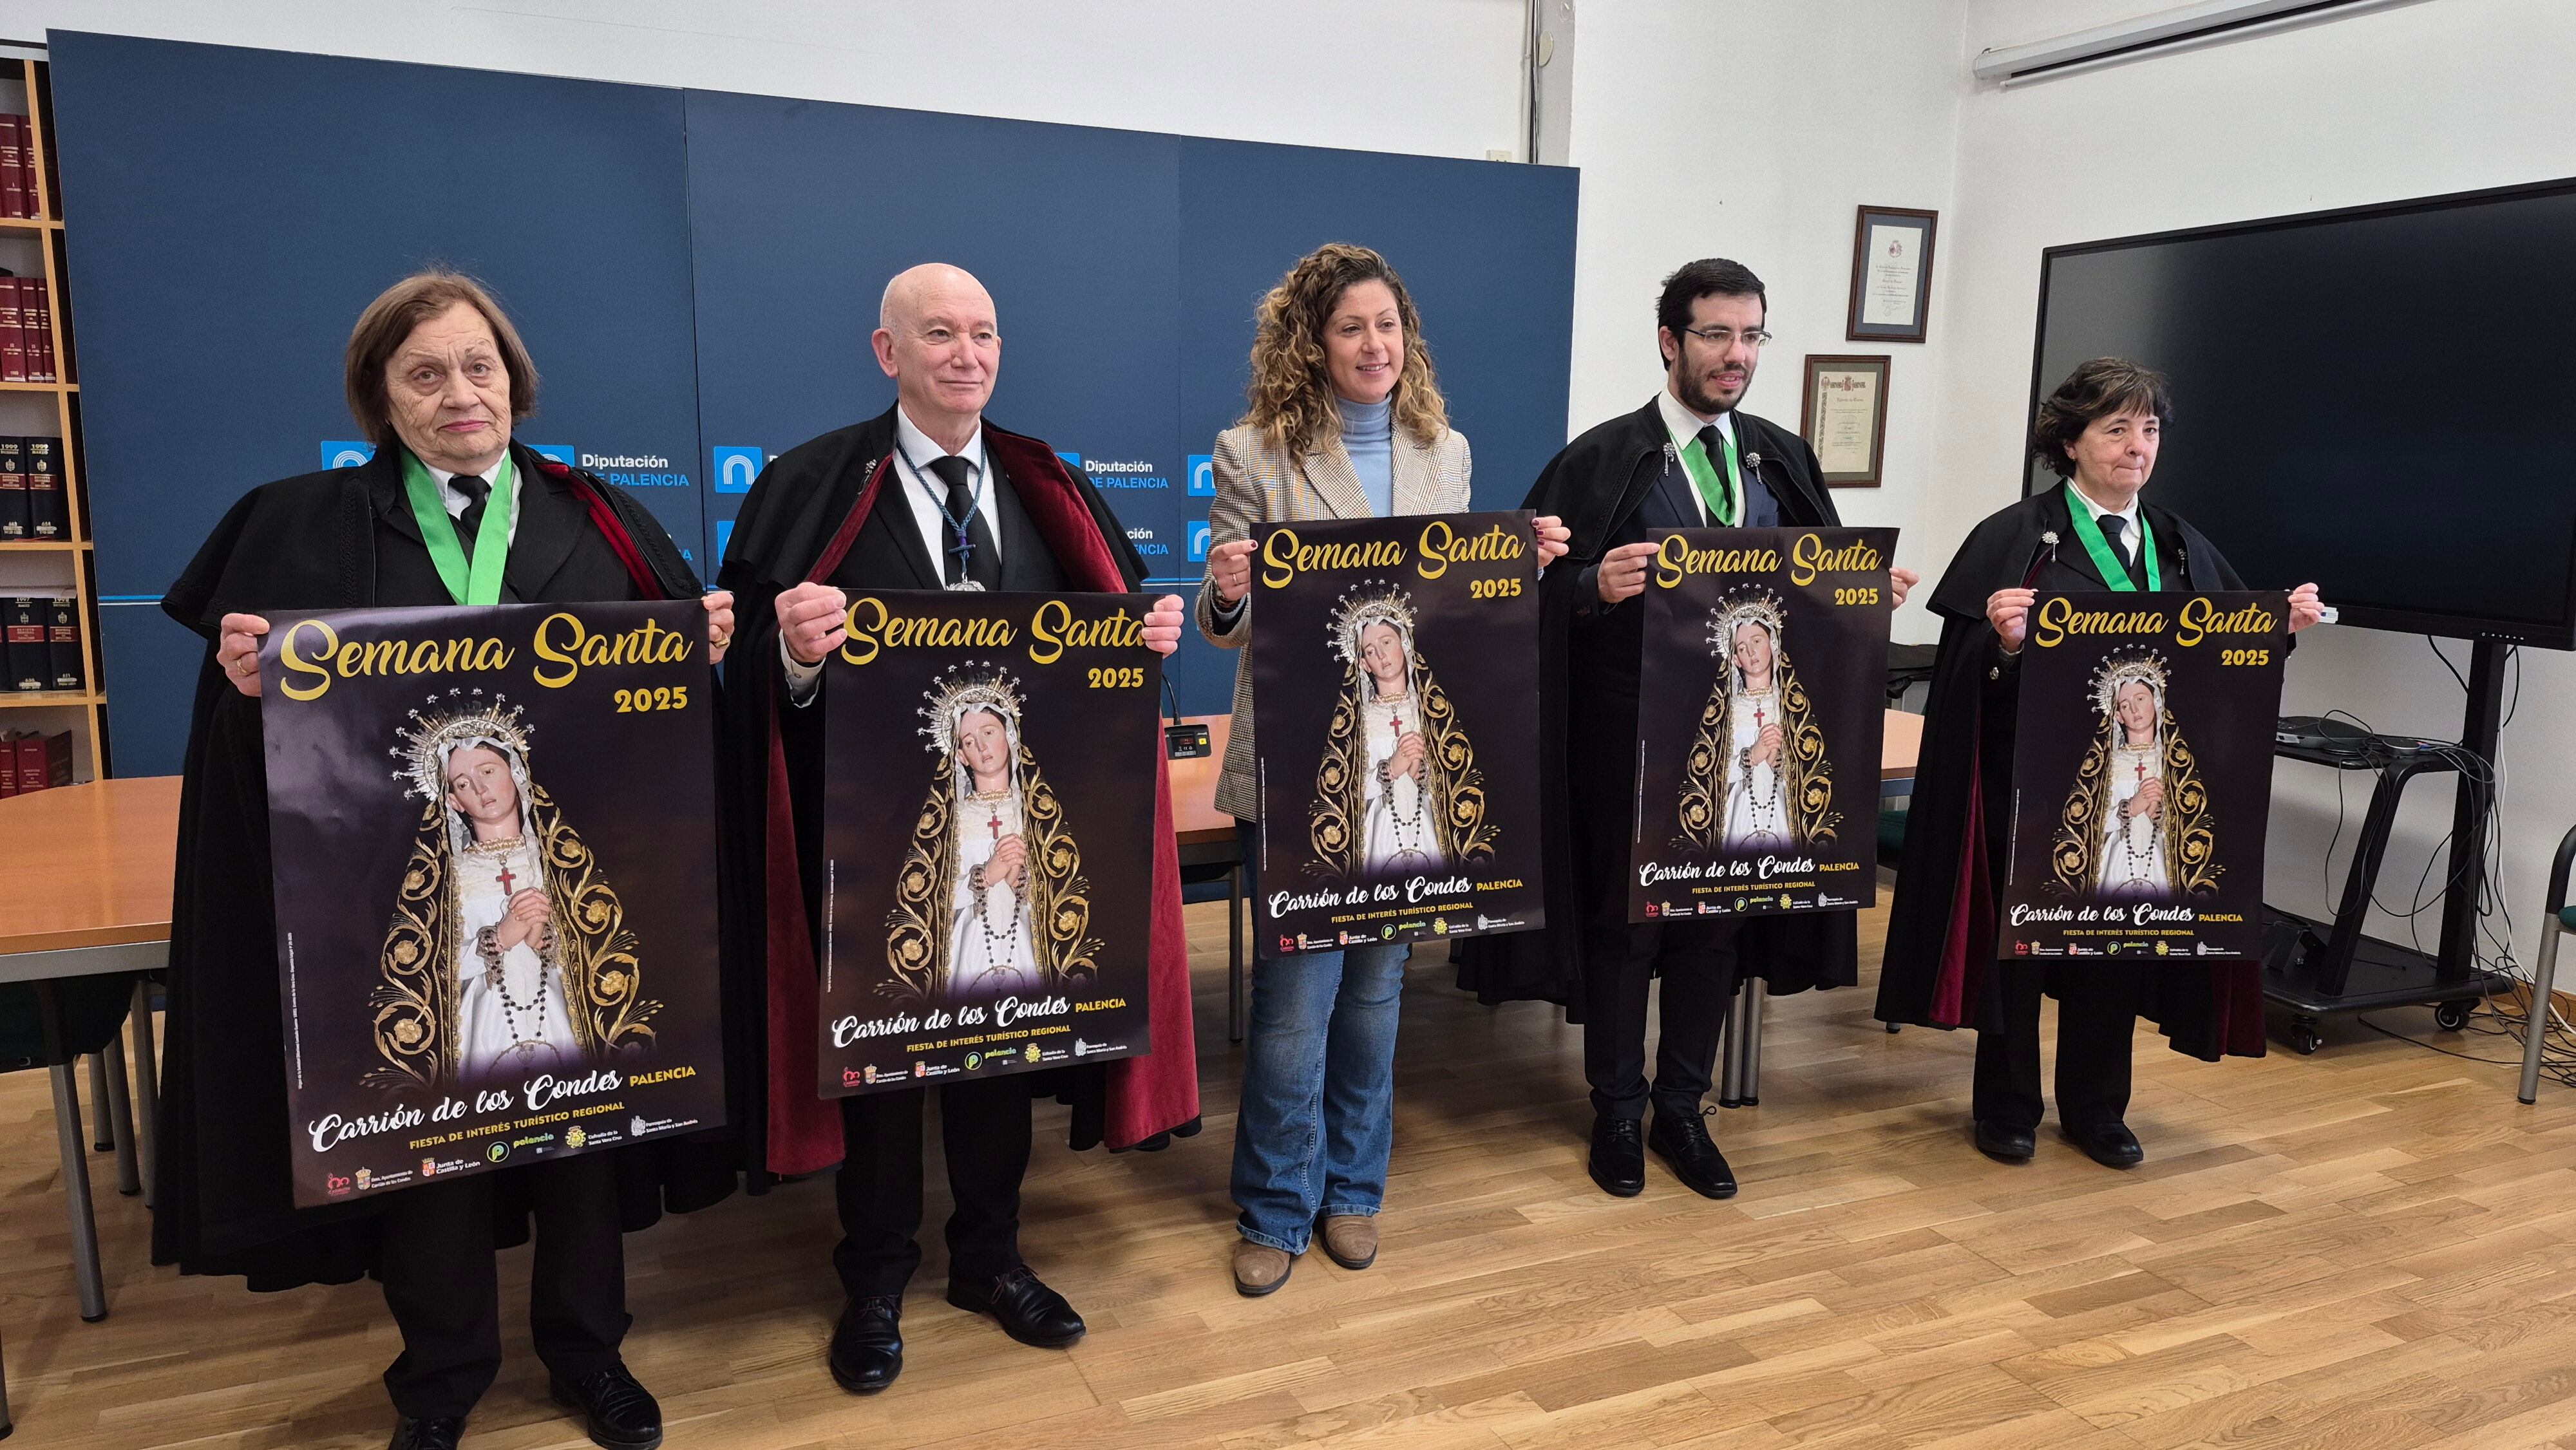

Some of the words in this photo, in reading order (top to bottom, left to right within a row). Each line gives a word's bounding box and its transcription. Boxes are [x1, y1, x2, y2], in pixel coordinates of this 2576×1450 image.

[582, 453, 668, 469] Diputación
[1085, 460, 1153, 474] Diputación
[610, 473, 690, 487] PALENCIA
[1107, 478, 1169, 489] PALENCIA
[1262, 529, 1408, 589] Semana
[1417, 520, 1526, 579] Santa
[1656, 534, 1783, 588] Semana
[1790, 533, 1883, 587] Santa
[1470, 578, 1522, 599] 2025
[1834, 588, 1879, 606] 2025
[841, 597, 1018, 665] Semana
[1029, 599, 1146, 664] Santa
[2035, 597, 2169, 648] Semana
[2176, 597, 2278, 646] Santa
[280, 620, 515, 701] Semana
[533, 612, 694, 688] Santa
[2221, 649, 2269, 666] 2025
[1088, 668, 1144, 688] 2025
[614, 686, 688, 713] 2025
[1639, 862, 1702, 887] Carrión
[1705, 860, 1726, 878] de
[1729, 860, 1752, 876] los
[1757, 855, 1816, 880] Condes
[1819, 862, 1860, 872] PALENCIA
[1269, 887, 1341, 919] Carrión
[1346, 885, 1369, 905] de
[1374, 883, 1399, 901] los
[1405, 876, 1472, 903] Condes
[1477, 880, 1523, 892] PALENCIA
[1723, 883, 1749, 892] INTERÉS
[1750, 881, 1783, 890] TURÍSTICO
[1785, 880, 1815, 889] REGIONAL
[1331, 916, 1355, 925] FIESTA
[1368, 908, 1397, 919] INTERÉS
[1399, 904, 1436, 917] TURÍSTICO
[1438, 901, 1473, 912] REGIONAL
[2010, 903, 2074, 927] Carrión
[2077, 905, 2099, 922] de
[2103, 905, 2127, 922] los
[2132, 903, 2195, 926] Condes
[2198, 913, 2243, 923] PALENCIA
[2125, 928, 2159, 936] TURÍSTICO
[831, 1012, 920, 1048] Carrión
[925, 1009, 952, 1030] de
[958, 1006, 989, 1026] los
[995, 995, 1072, 1028] Condes
[1075, 997, 1127, 1013] PALENCIA
[906, 1042, 934, 1053] FIESTA
[936, 1040, 948, 1048] DE
[950, 1034, 984, 1046] INTERÉS
[986, 1030, 1028, 1042] TURÍSTICO
[1031, 1024, 1071, 1035] REGIONAL
[308, 1103, 426, 1153] Carrión
[432, 1097, 468, 1122] de
[476, 1089, 515, 1114] los
[524, 1069, 623, 1111] Condes
[629, 1066, 696, 1087] PALENCIA
[410, 1136, 446, 1149] FIESTA
[449, 1131, 464, 1142] DE
[467, 1122, 511, 1138] INTERÉS
[514, 1111, 569, 1129] TURÍSTICO
[573, 1102, 625, 1118] REGIONAL
